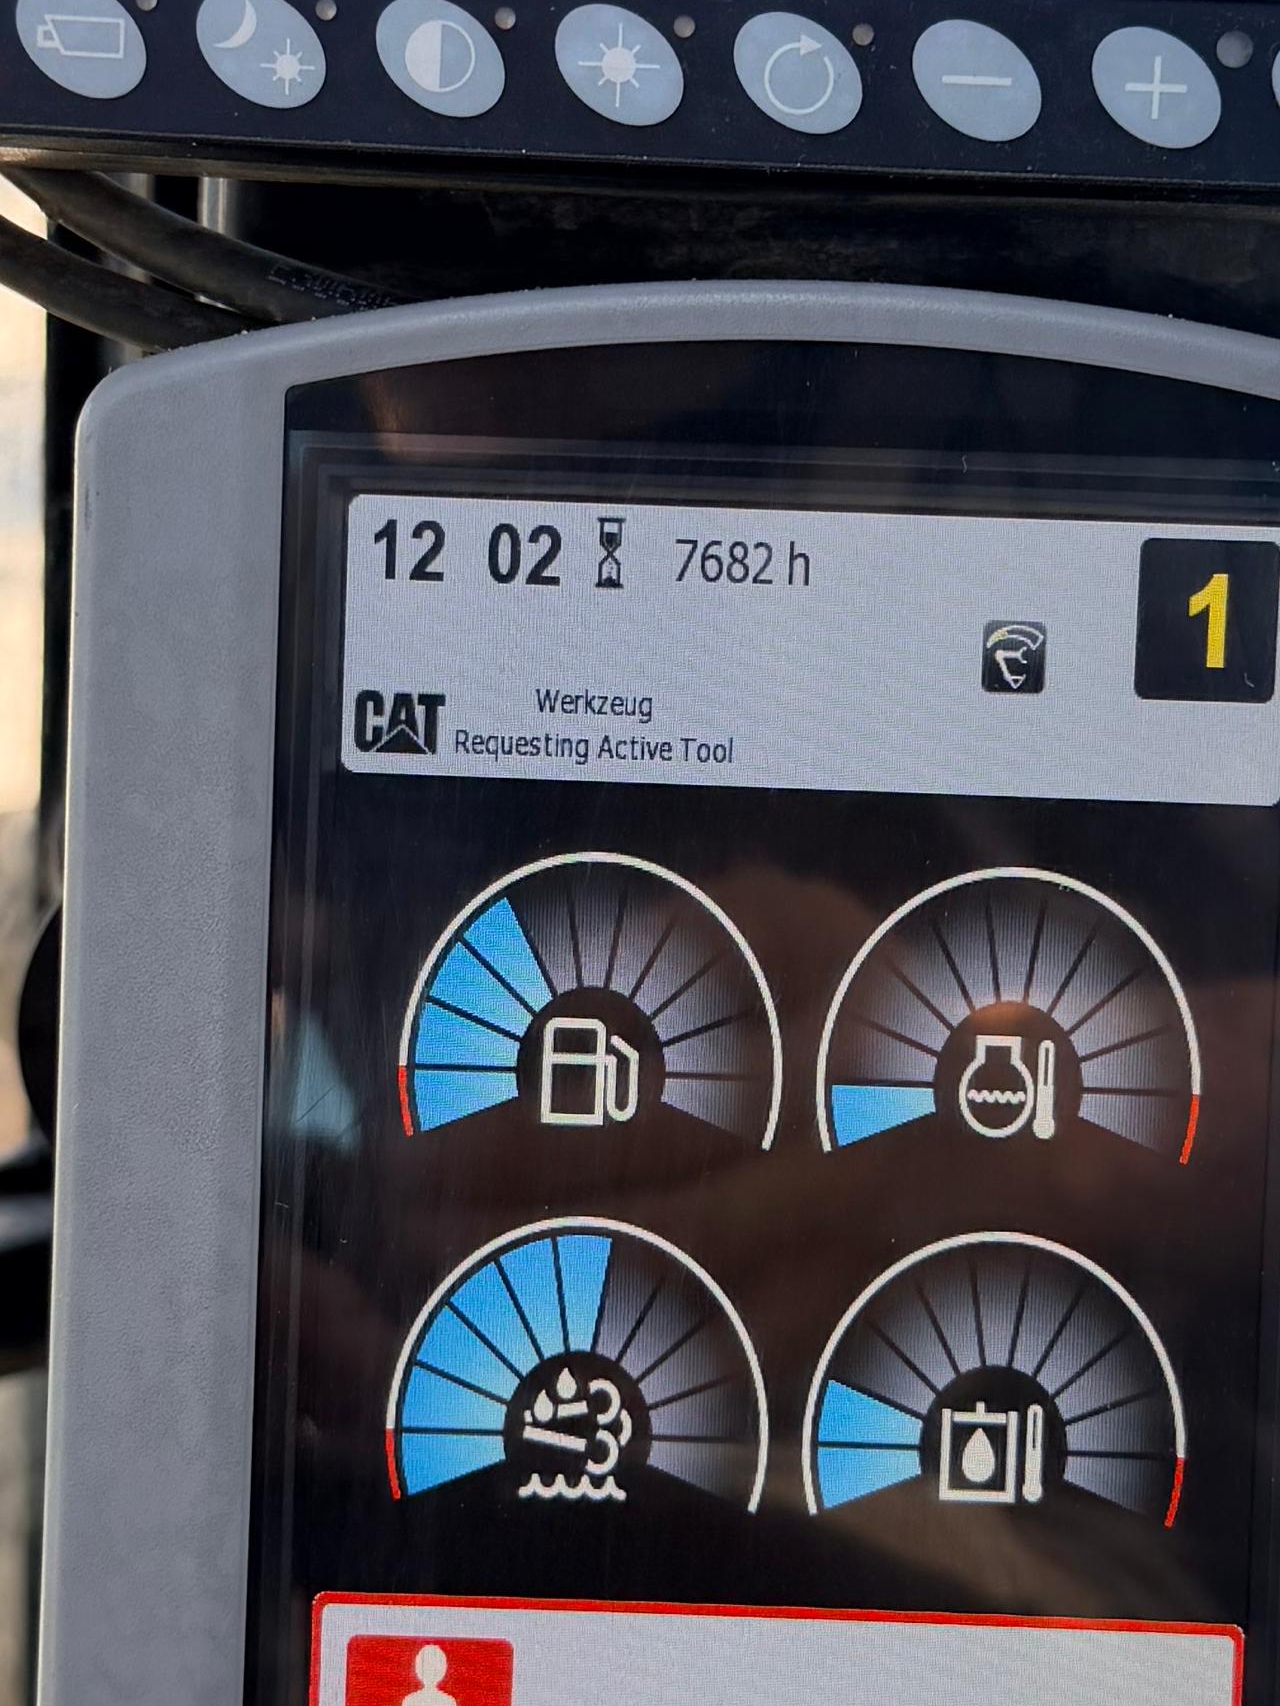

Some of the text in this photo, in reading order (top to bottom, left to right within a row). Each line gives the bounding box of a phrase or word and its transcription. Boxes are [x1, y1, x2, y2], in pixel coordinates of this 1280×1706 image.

[373, 518, 811, 586] 12 02 7682 h
[1188, 573, 1229, 669] 1
[353, 690, 446, 755] CAT
[535, 689, 653, 723] Werkzeug
[455, 730, 734, 765] Requesting Active Tool
